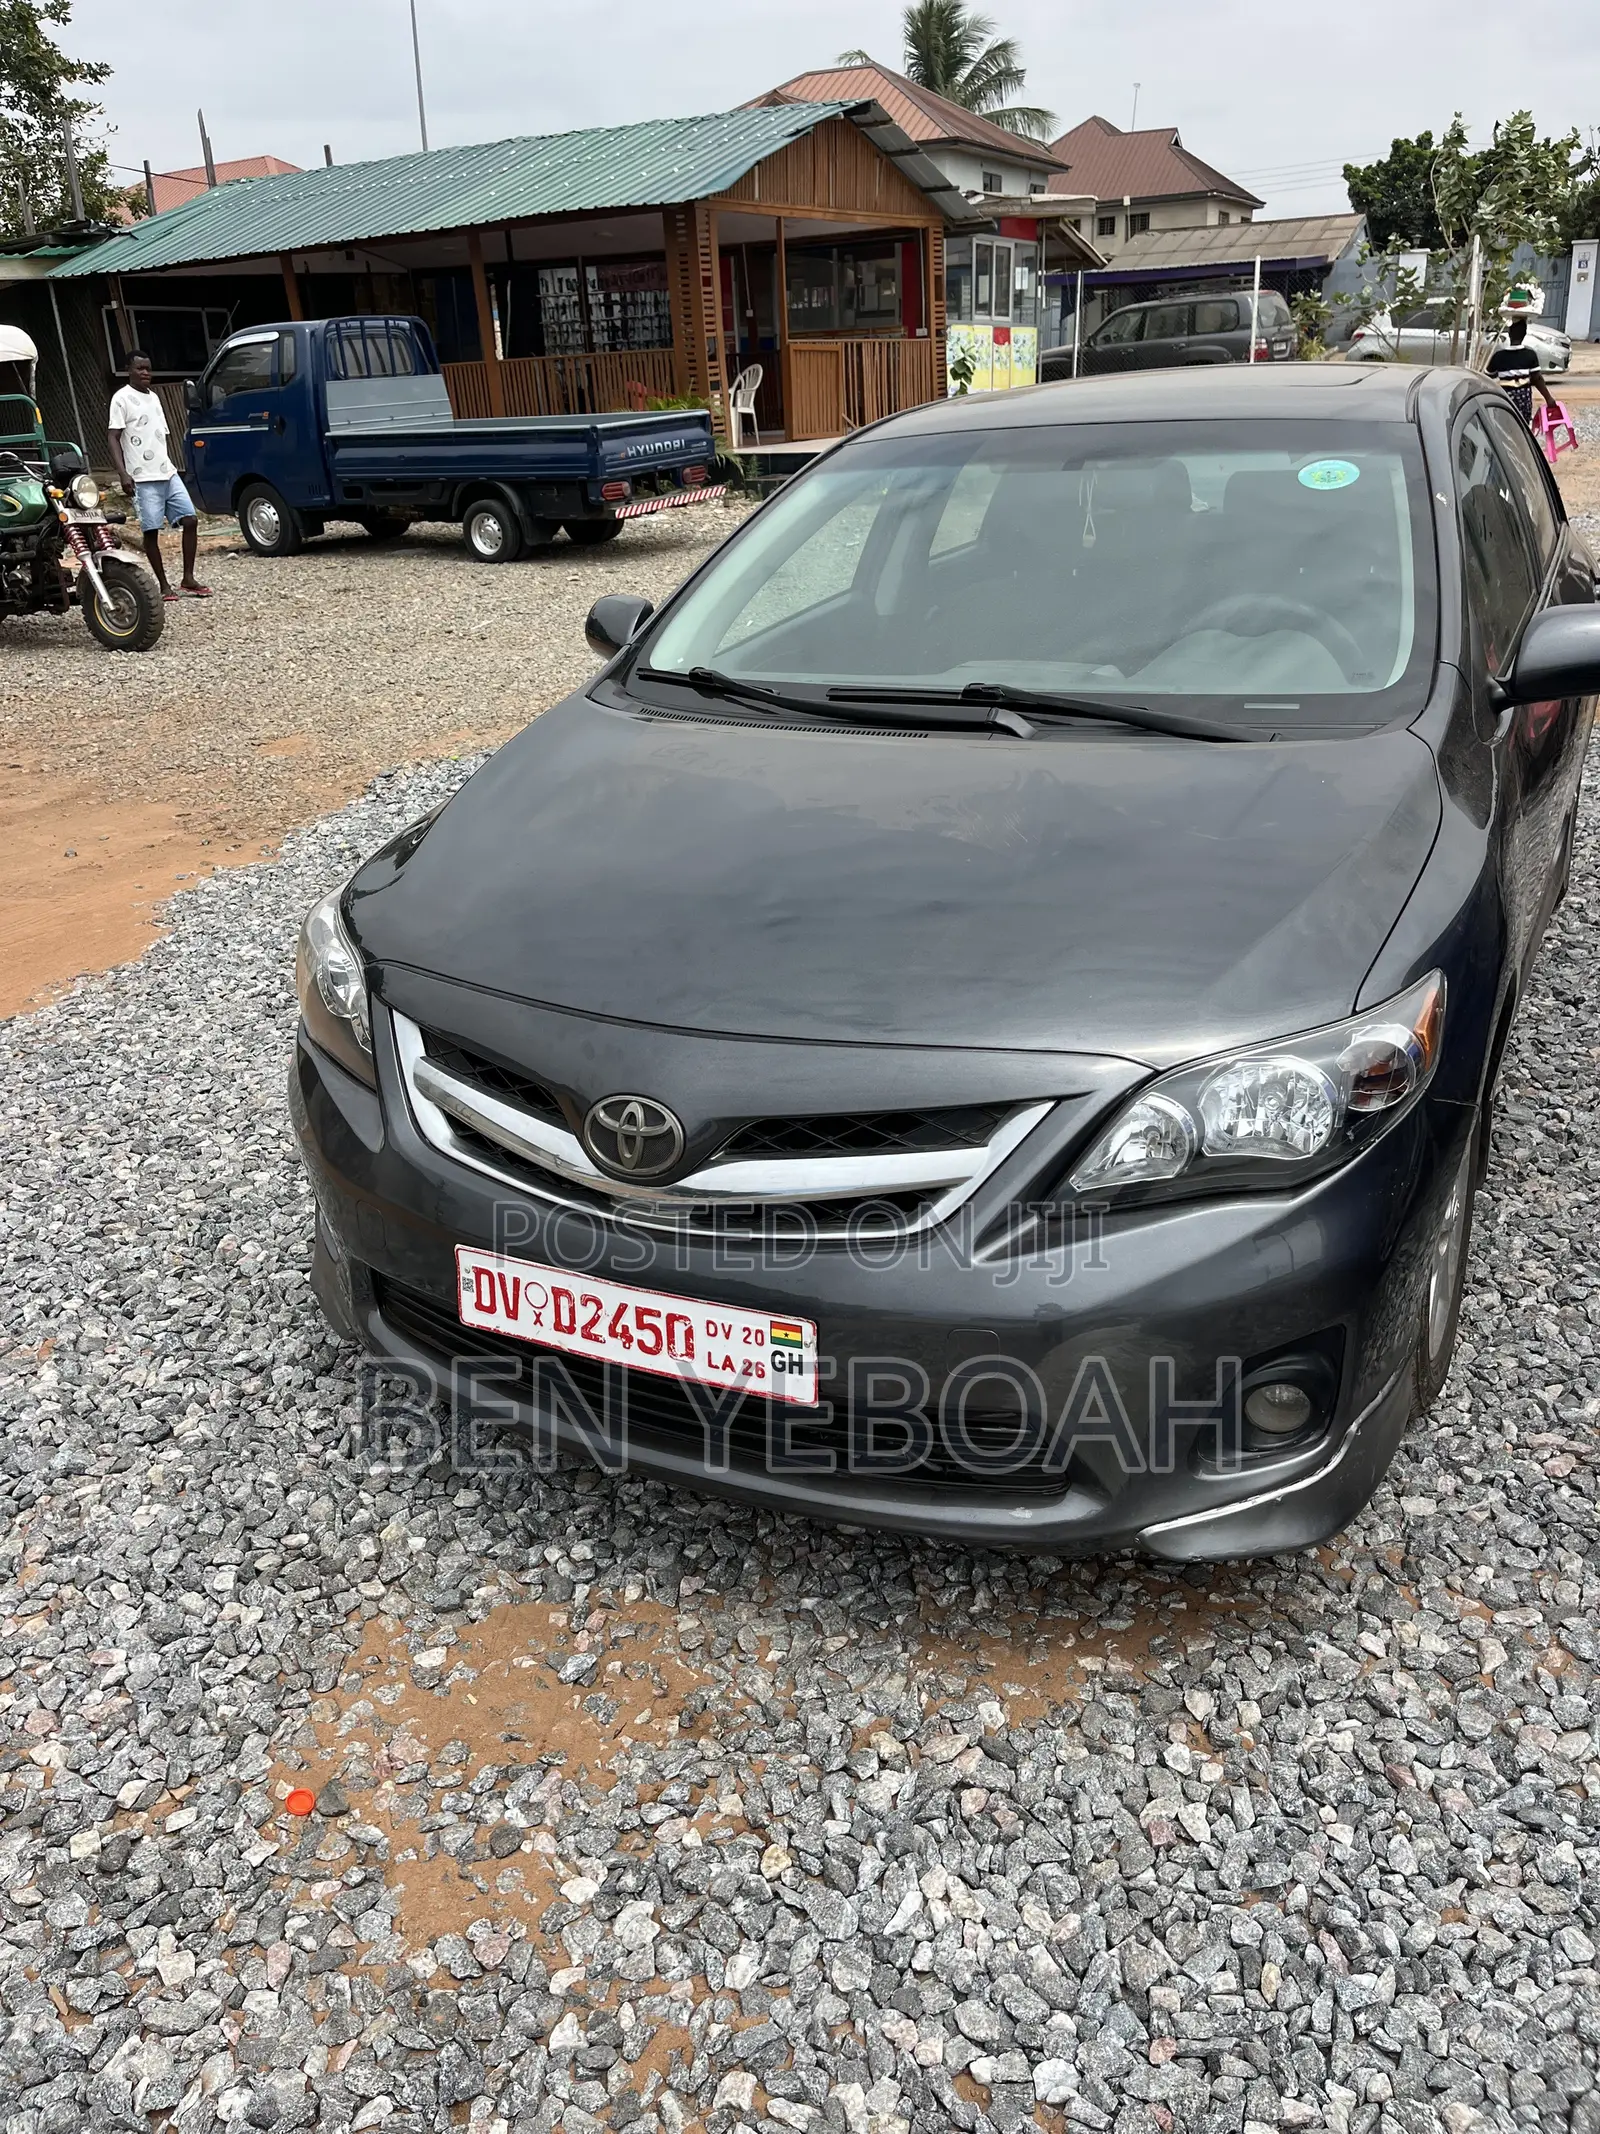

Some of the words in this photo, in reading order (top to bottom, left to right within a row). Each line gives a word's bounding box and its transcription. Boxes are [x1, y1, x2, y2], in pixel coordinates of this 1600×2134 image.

[627, 439, 685, 457] HYUNDAI
[472, 1265, 520, 1321] DV
[551, 1286, 695, 1362] D2450
[705, 1319, 733, 1340] DV
[742, 1327, 765, 1347] 20
[707, 1351, 735, 1373] LA
[741, 1358, 766, 1379] 26
[770, 1350, 804, 1376] GH
